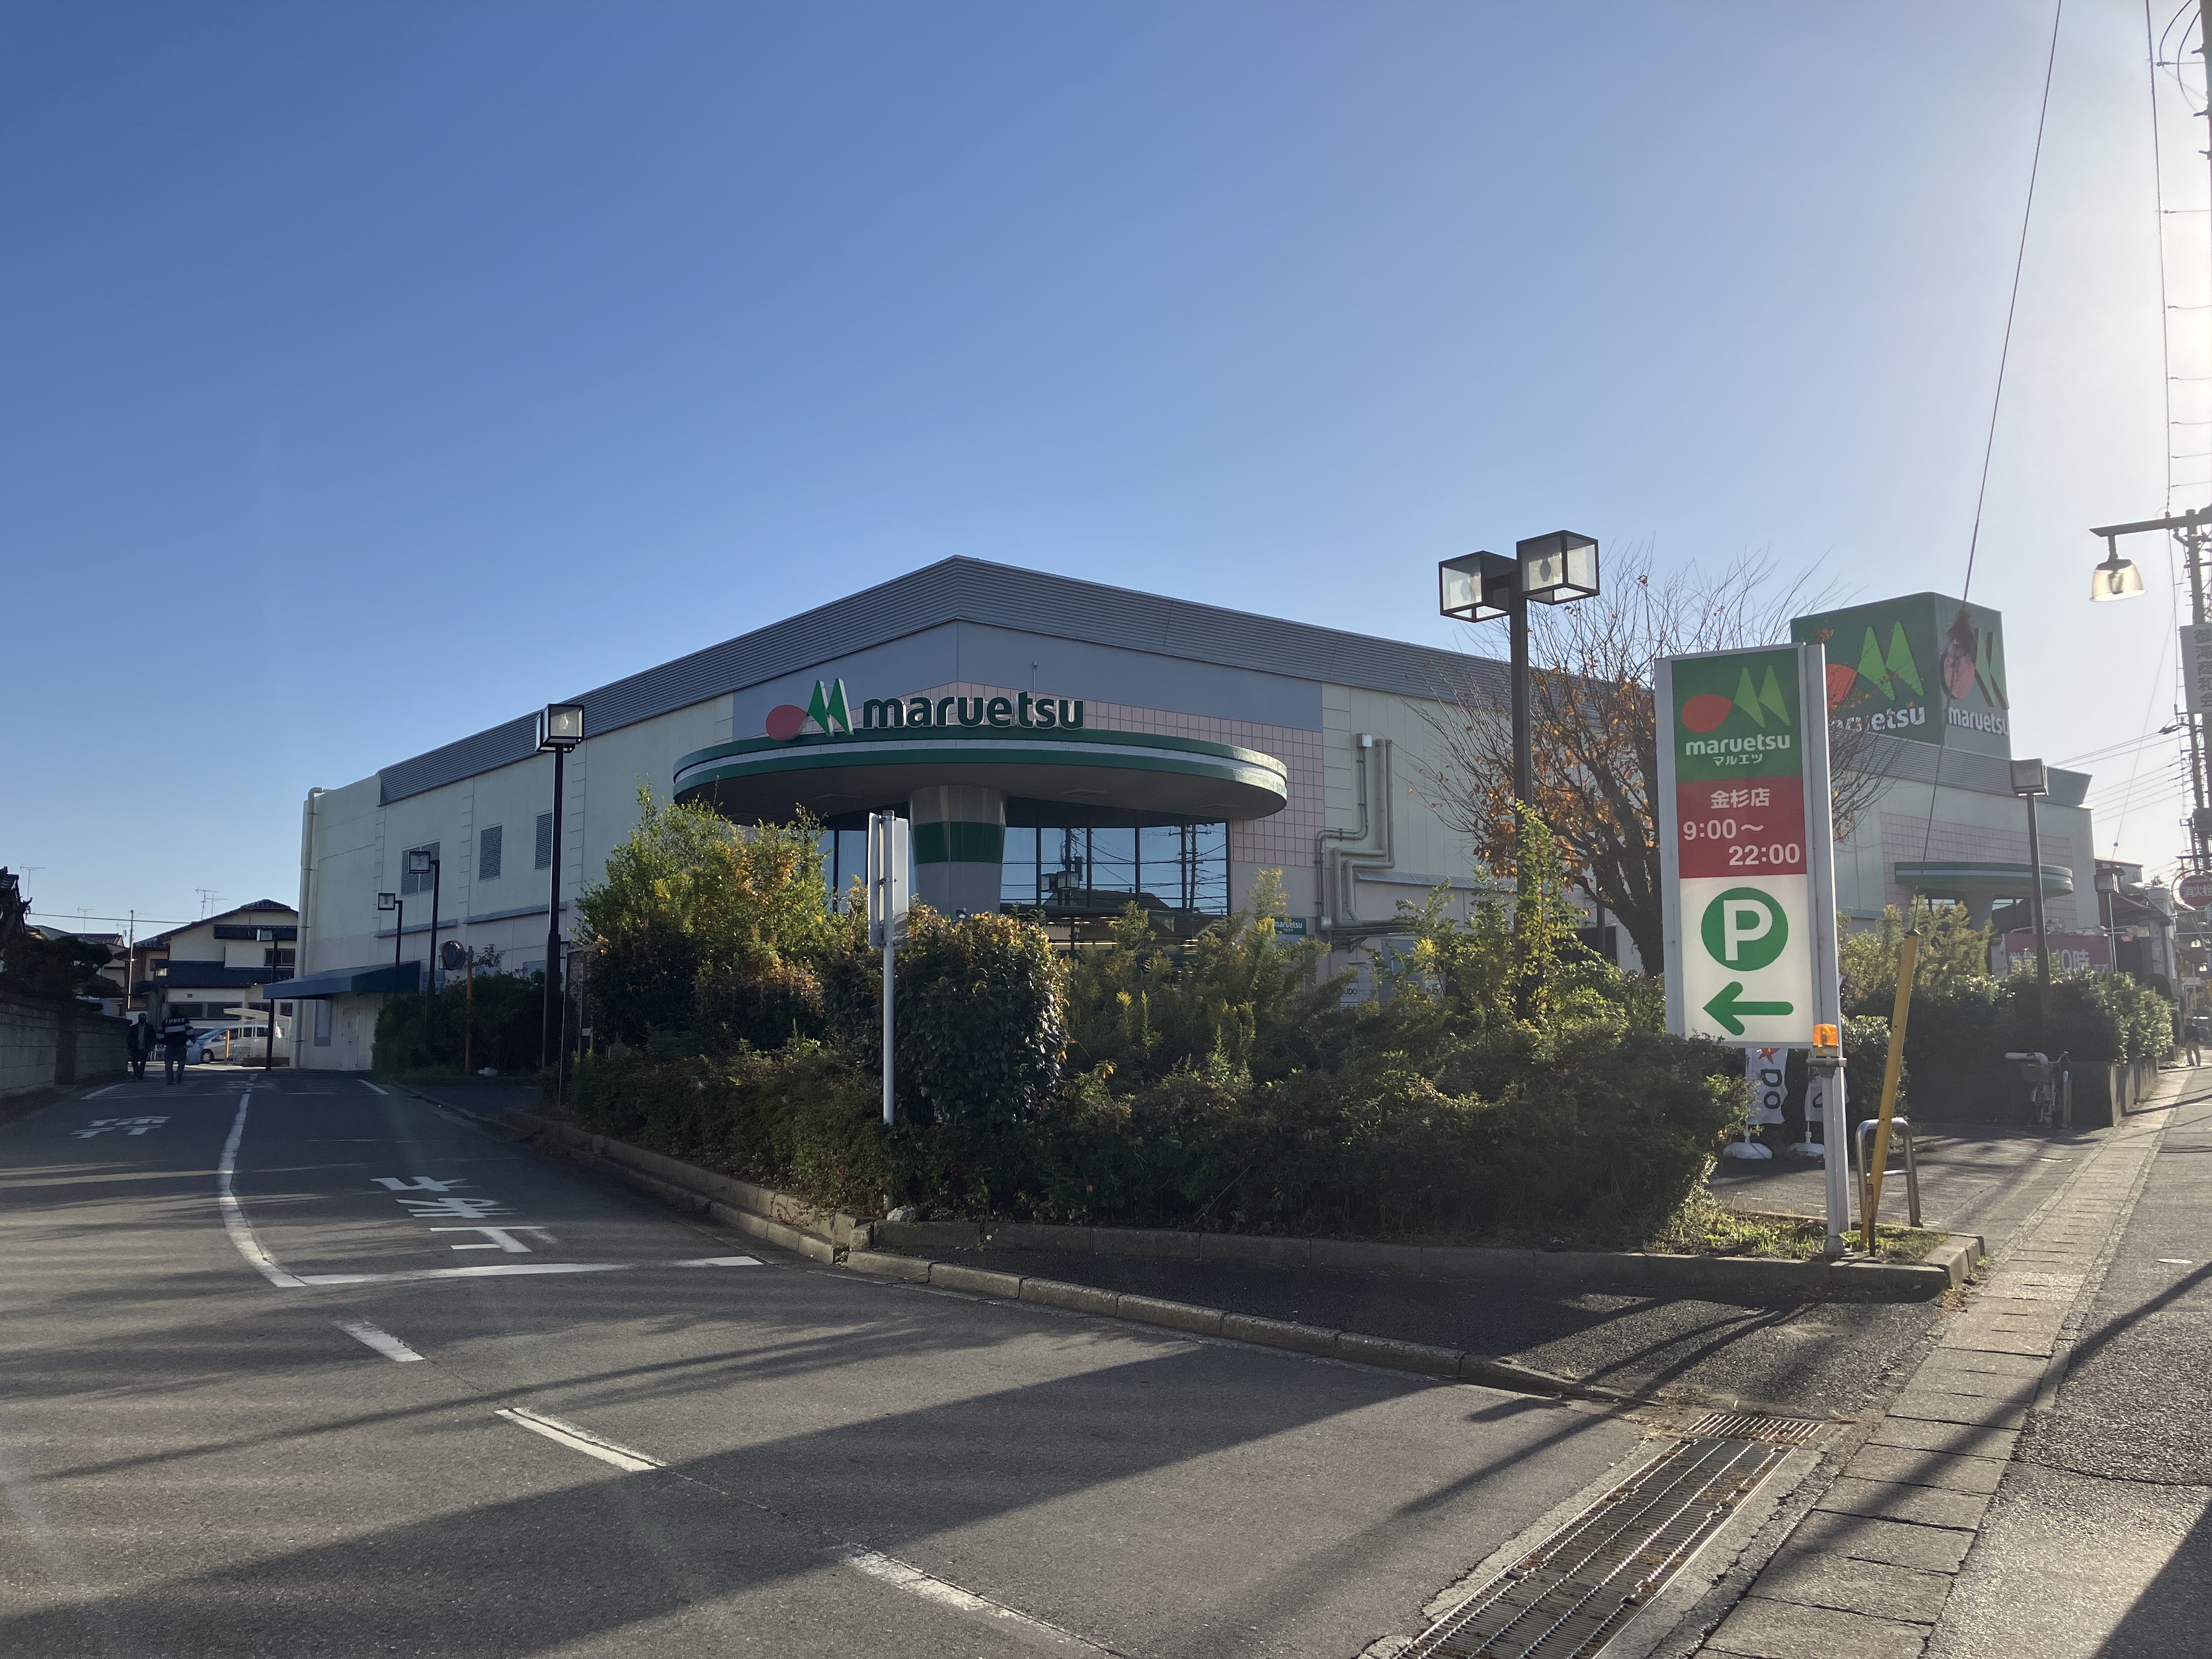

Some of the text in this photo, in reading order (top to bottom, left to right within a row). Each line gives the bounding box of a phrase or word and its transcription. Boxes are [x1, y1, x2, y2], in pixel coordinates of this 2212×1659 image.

[863, 690, 1084, 730] maruetsu
[1948, 707, 2009, 735] maruetsu
[1685, 733, 1791, 755] maruetsu
[1713, 753, 1763, 766] マルエツ
[1710, 787, 1770, 809] 金杉店
[1728, 843, 1801, 866] 22:00
[2182, 883, 2212, 899] 消火栓
[1723, 899, 1773, 961] P
